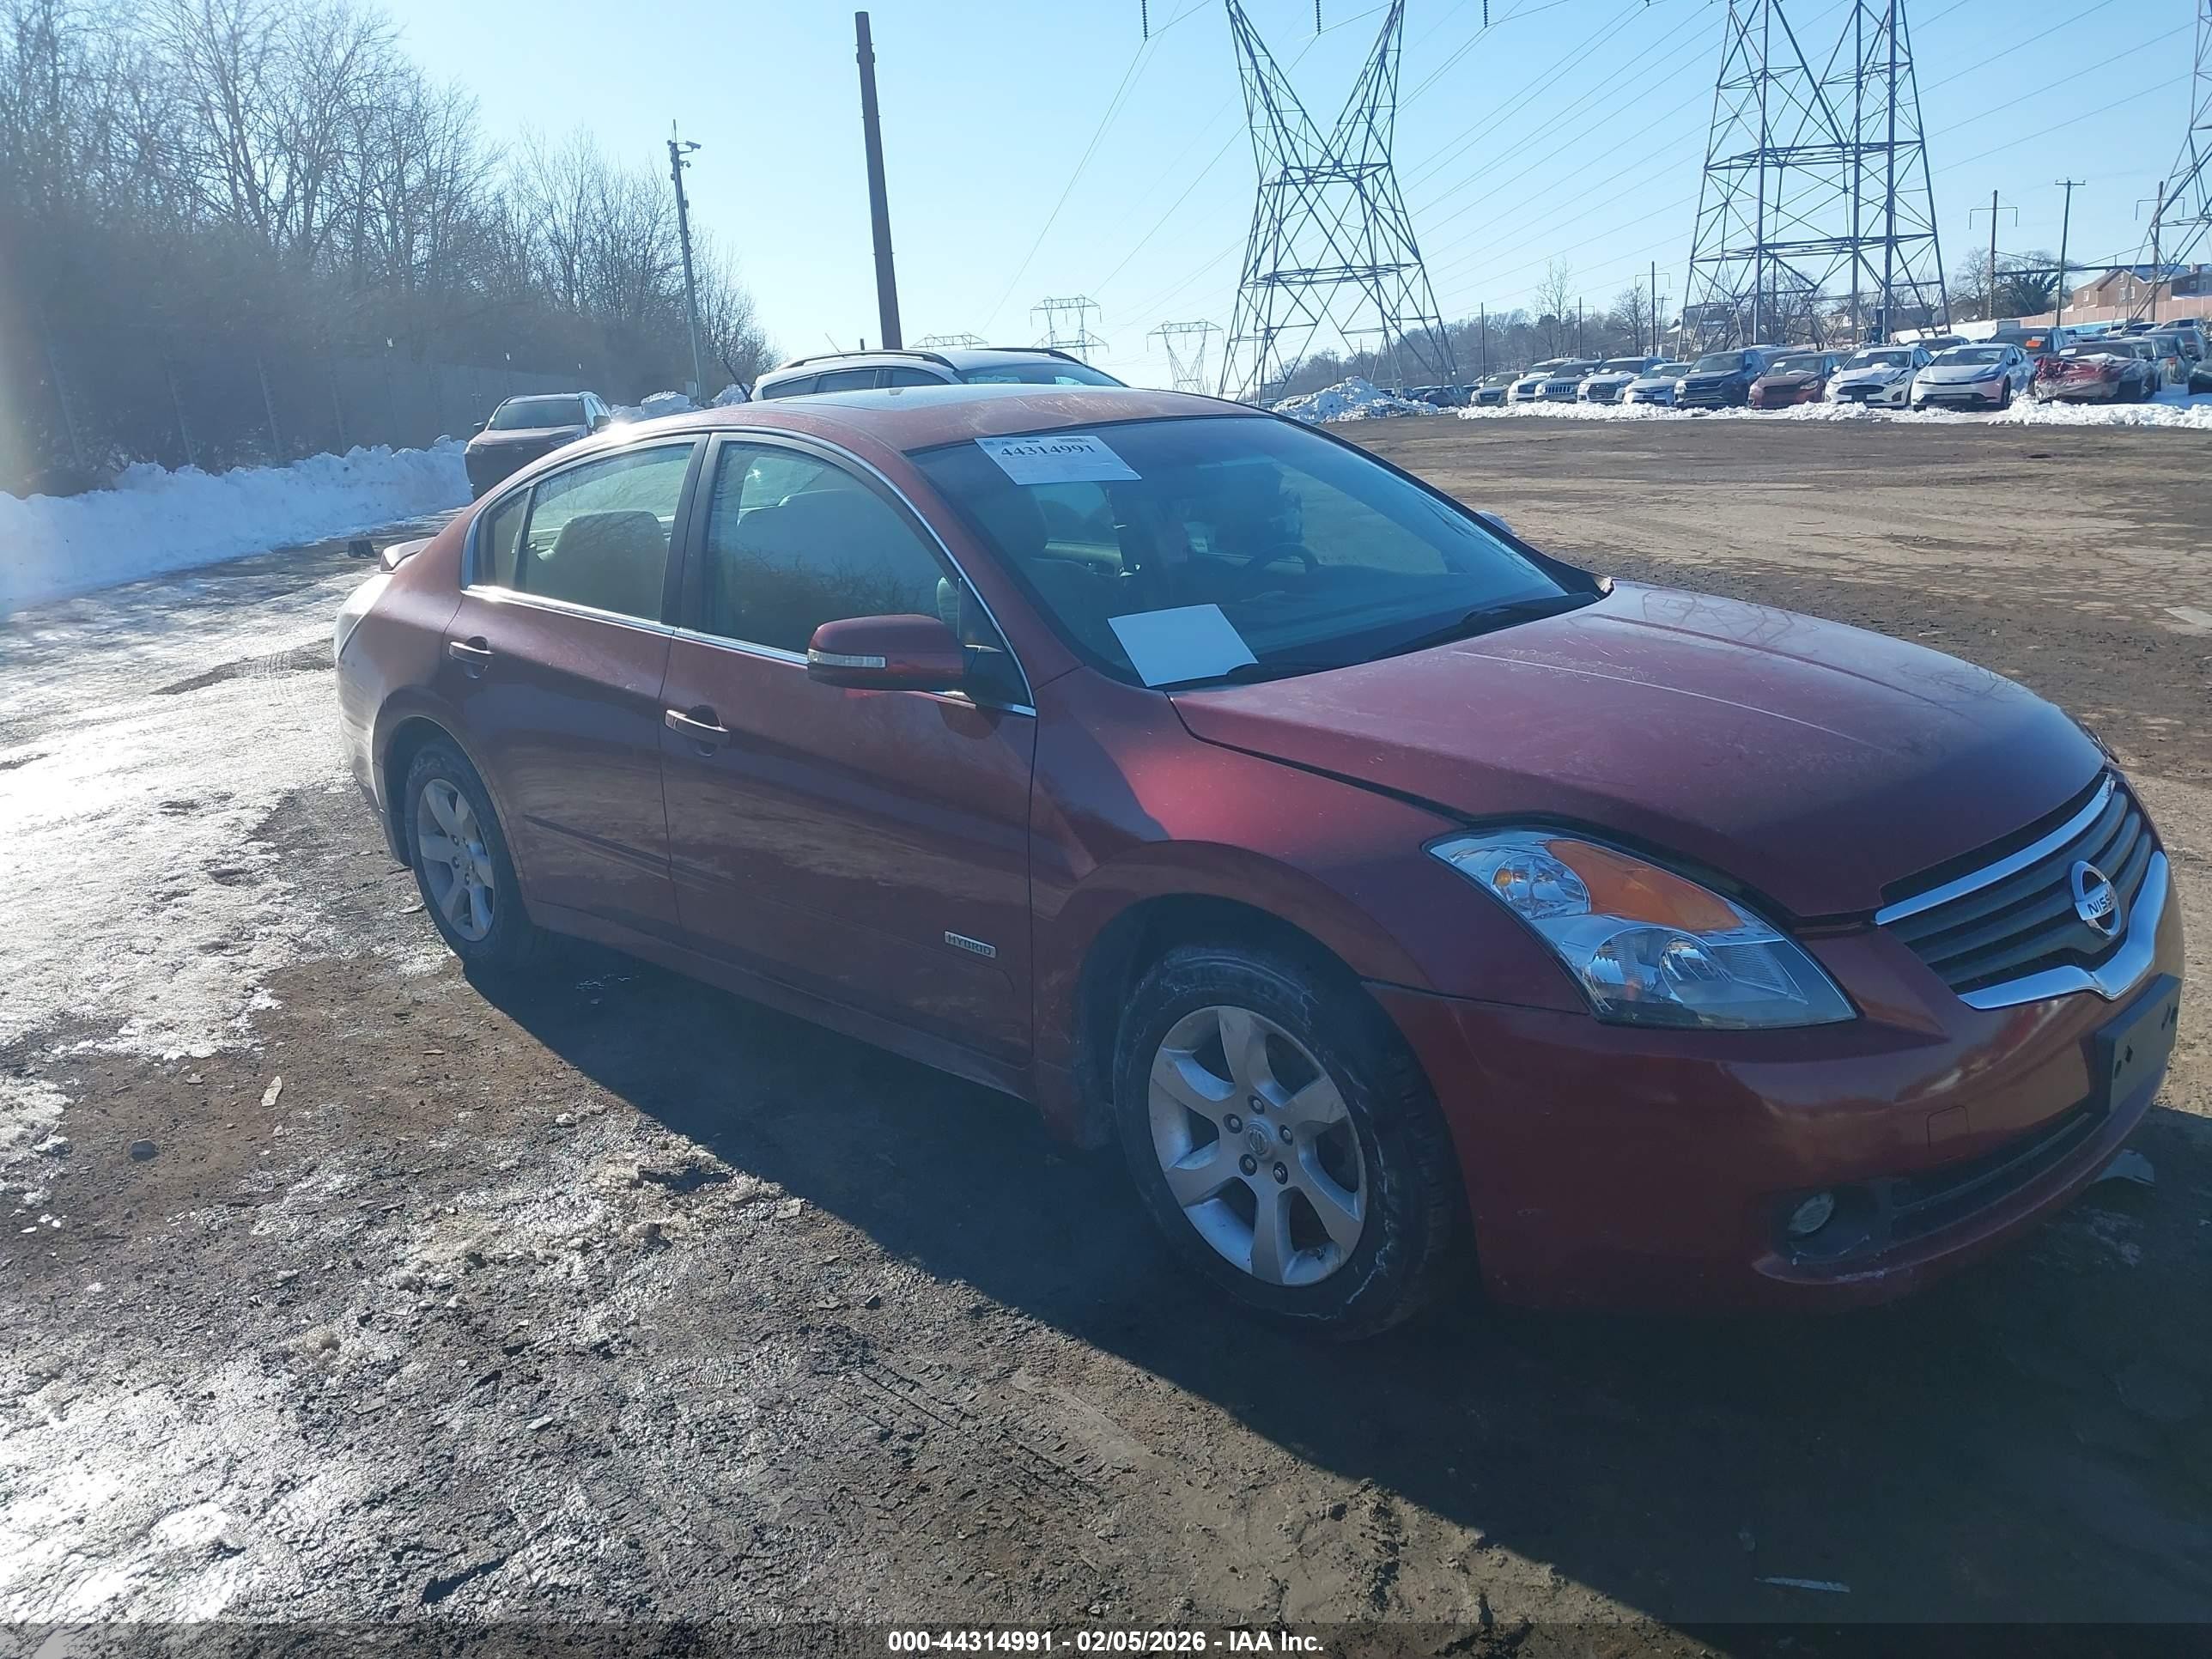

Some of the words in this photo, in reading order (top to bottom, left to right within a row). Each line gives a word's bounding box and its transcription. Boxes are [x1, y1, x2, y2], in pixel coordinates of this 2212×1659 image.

[1000, 444, 1097, 457] 44314991
[2087, 894, 2113, 915] NISS
[947, 933, 992, 955] HYBRID
